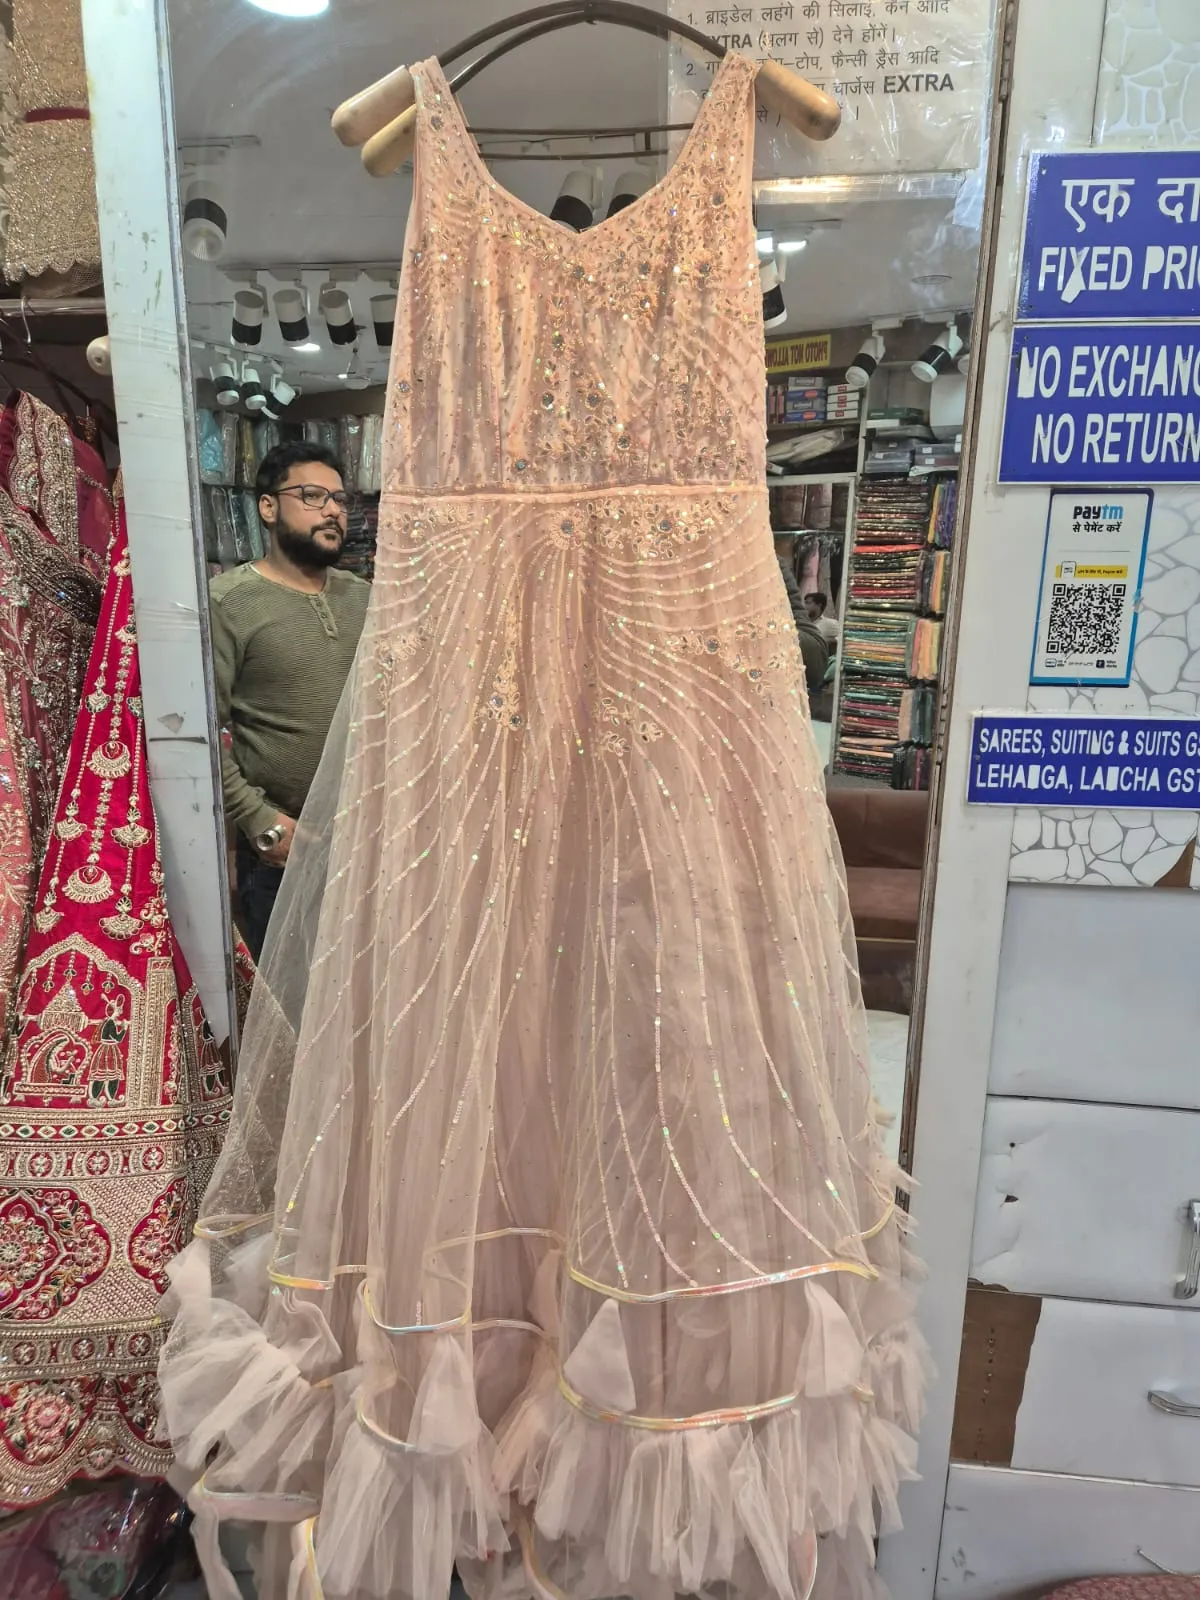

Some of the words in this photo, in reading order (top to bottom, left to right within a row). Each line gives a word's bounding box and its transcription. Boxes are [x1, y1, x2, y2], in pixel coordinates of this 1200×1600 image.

[761, 1, 794, 21] लहंगे
[802, 0, 820, 19] की
[706, 33, 752, 49] XTRA
[832, 24, 853, 44] देने
[907, 45, 942, 65] आदि
[882, 73, 954, 94] EXTRA
[1062, 178, 1135, 233] एक
[1038, 247, 1133, 292] FIXED
[1142, 246, 1200, 290] PRI
[1017, 347, 1062, 398] NO
[1031, 413, 1075, 463] NO
[1072, 521, 1082, 533] से
[1083, 521, 1104, 533] पेमेंट
[1106, 521, 1122, 533] करें
[979, 728, 1046, 757] SAREES,
[1051, 729, 1114, 755] SUITING
[1118, 730, 1129, 755] &
[1134, 731, 1182, 756] SUITS
[1186, 732, 1200, 756] G
[976, 764, 1073, 794] LEHAGA,
[1080, 766, 1160, 792] LACHA
